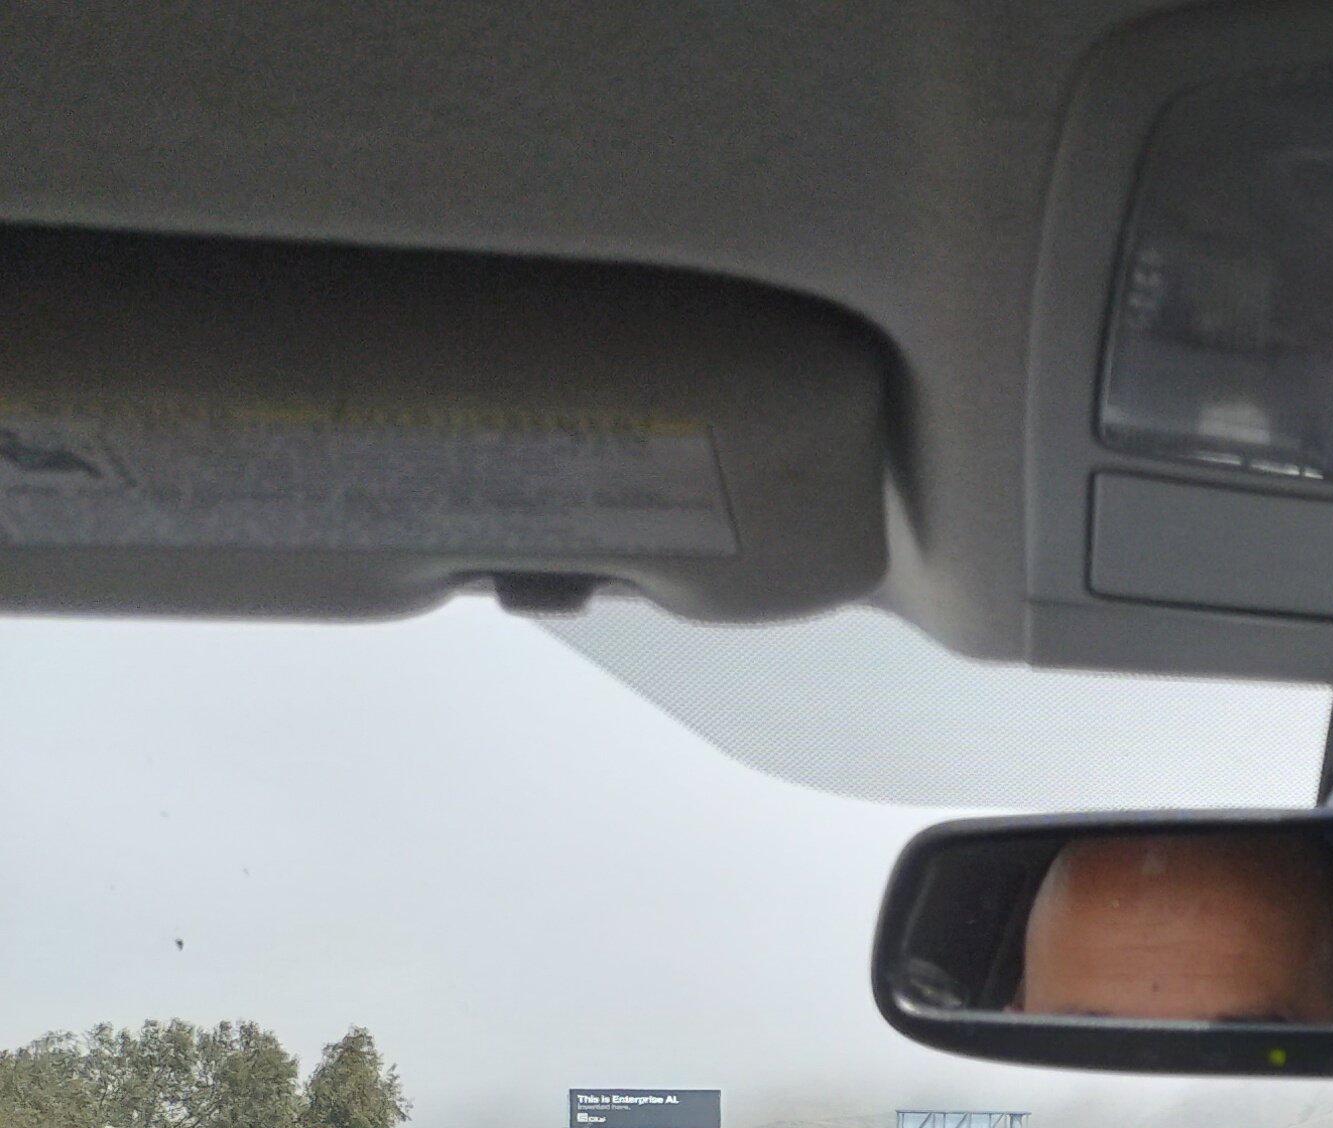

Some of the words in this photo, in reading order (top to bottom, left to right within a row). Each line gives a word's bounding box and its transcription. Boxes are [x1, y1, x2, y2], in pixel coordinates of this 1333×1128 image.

[577, 1095, 599, 1104] This
[601, 1095, 610, 1104] is
[612, 1095, 664, 1105] Enterprise
